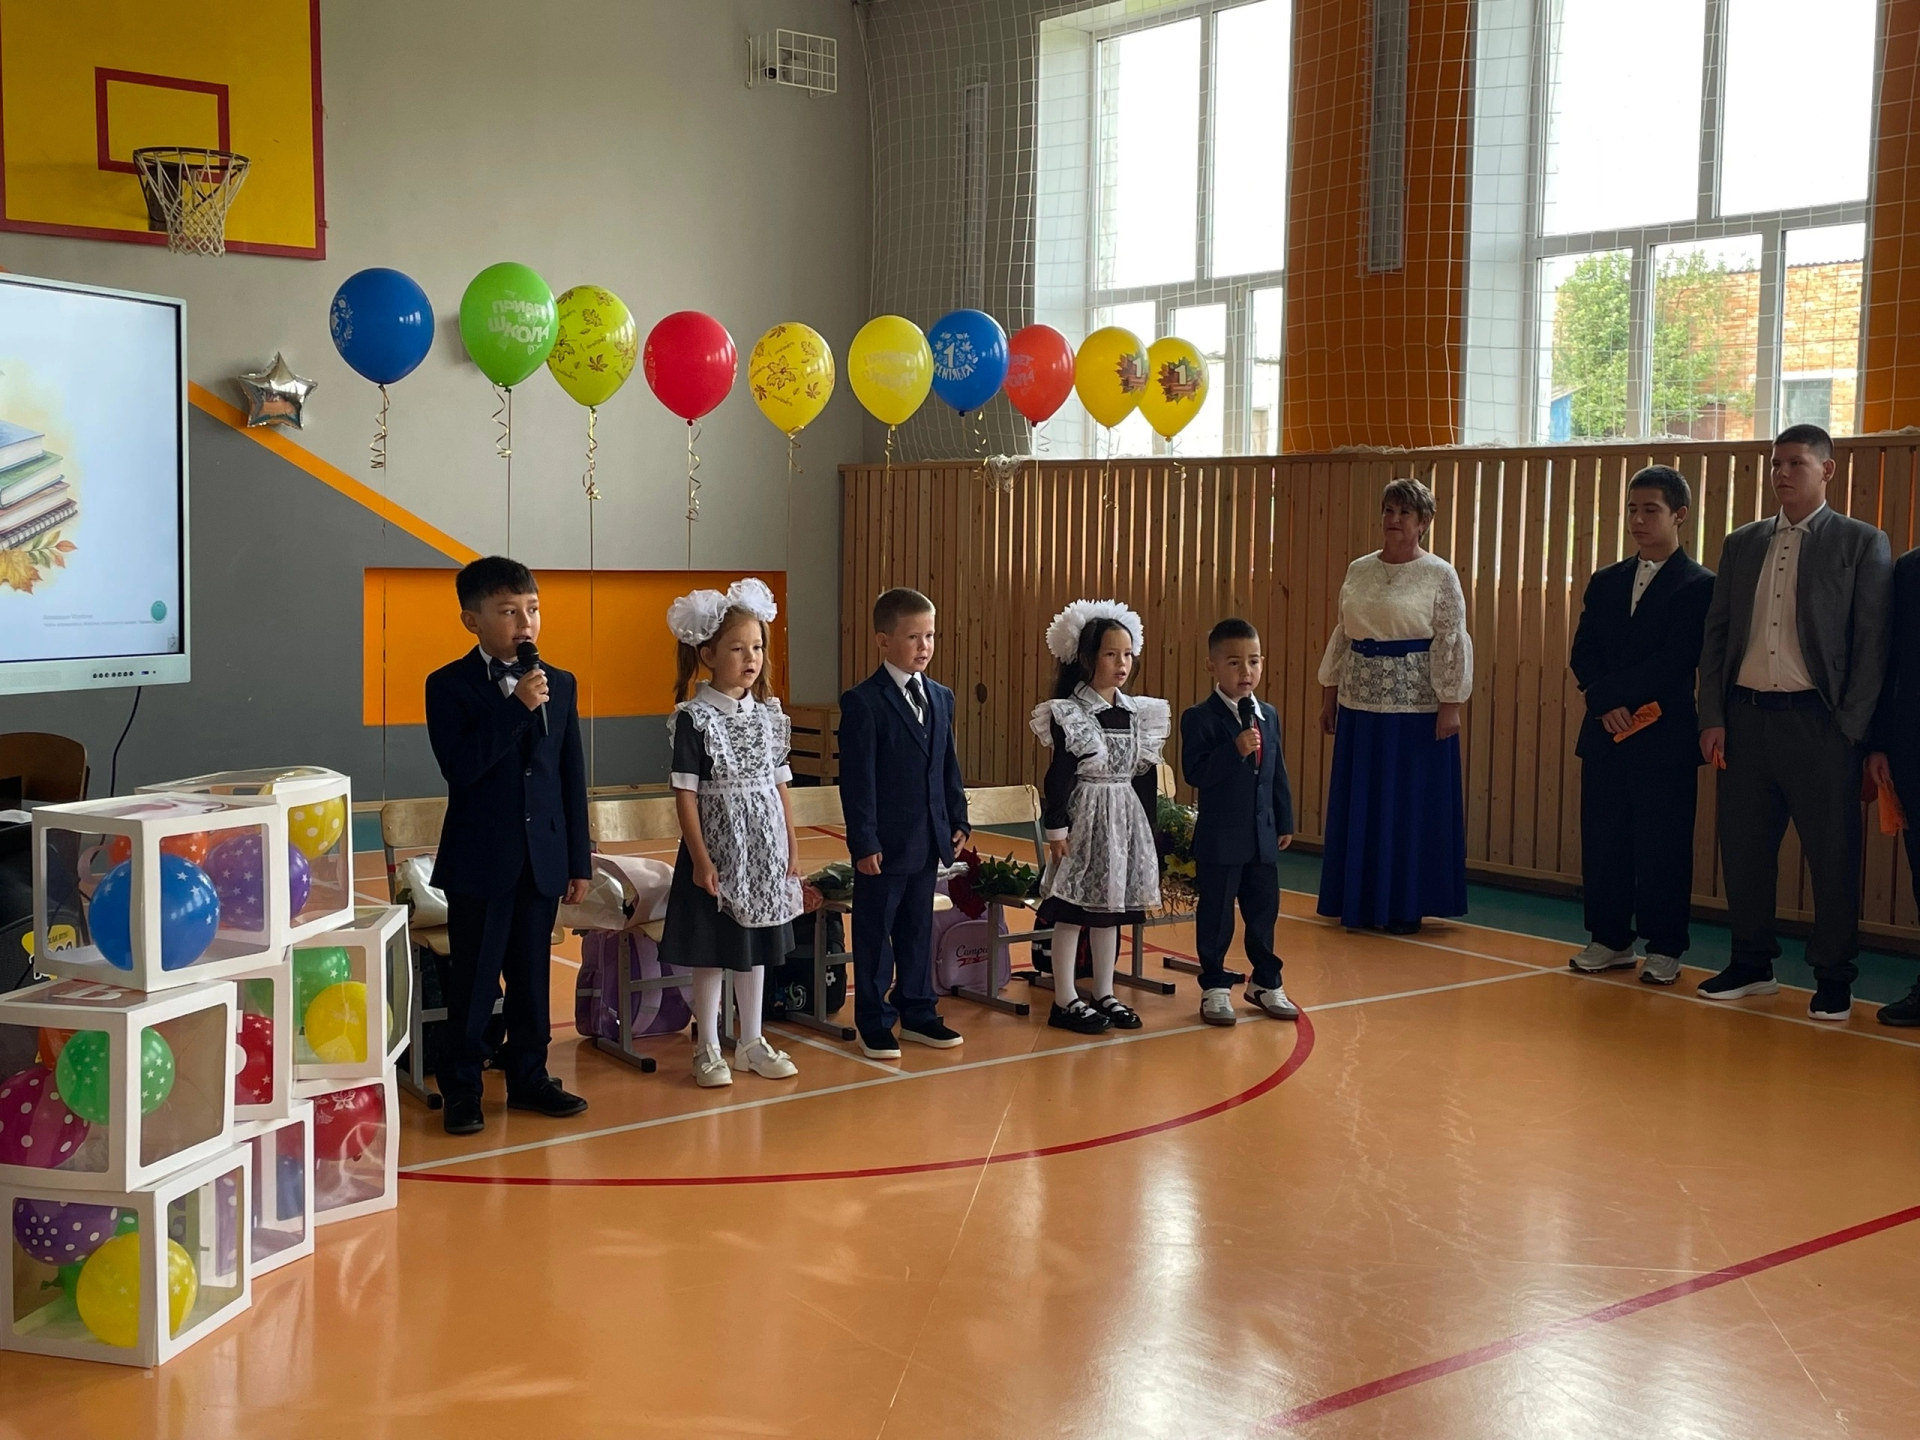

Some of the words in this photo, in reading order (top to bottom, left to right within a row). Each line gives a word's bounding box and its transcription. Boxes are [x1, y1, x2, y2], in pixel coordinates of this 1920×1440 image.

[488, 315, 550, 343] ШКОЛА
[943, 342, 955, 369] 1
[934, 363, 974, 381] СЕНТЯБРЯ
[1132, 357, 1142, 378] 1
[1174, 365, 1187, 385] 1
[955, 945, 989, 958] Campu
